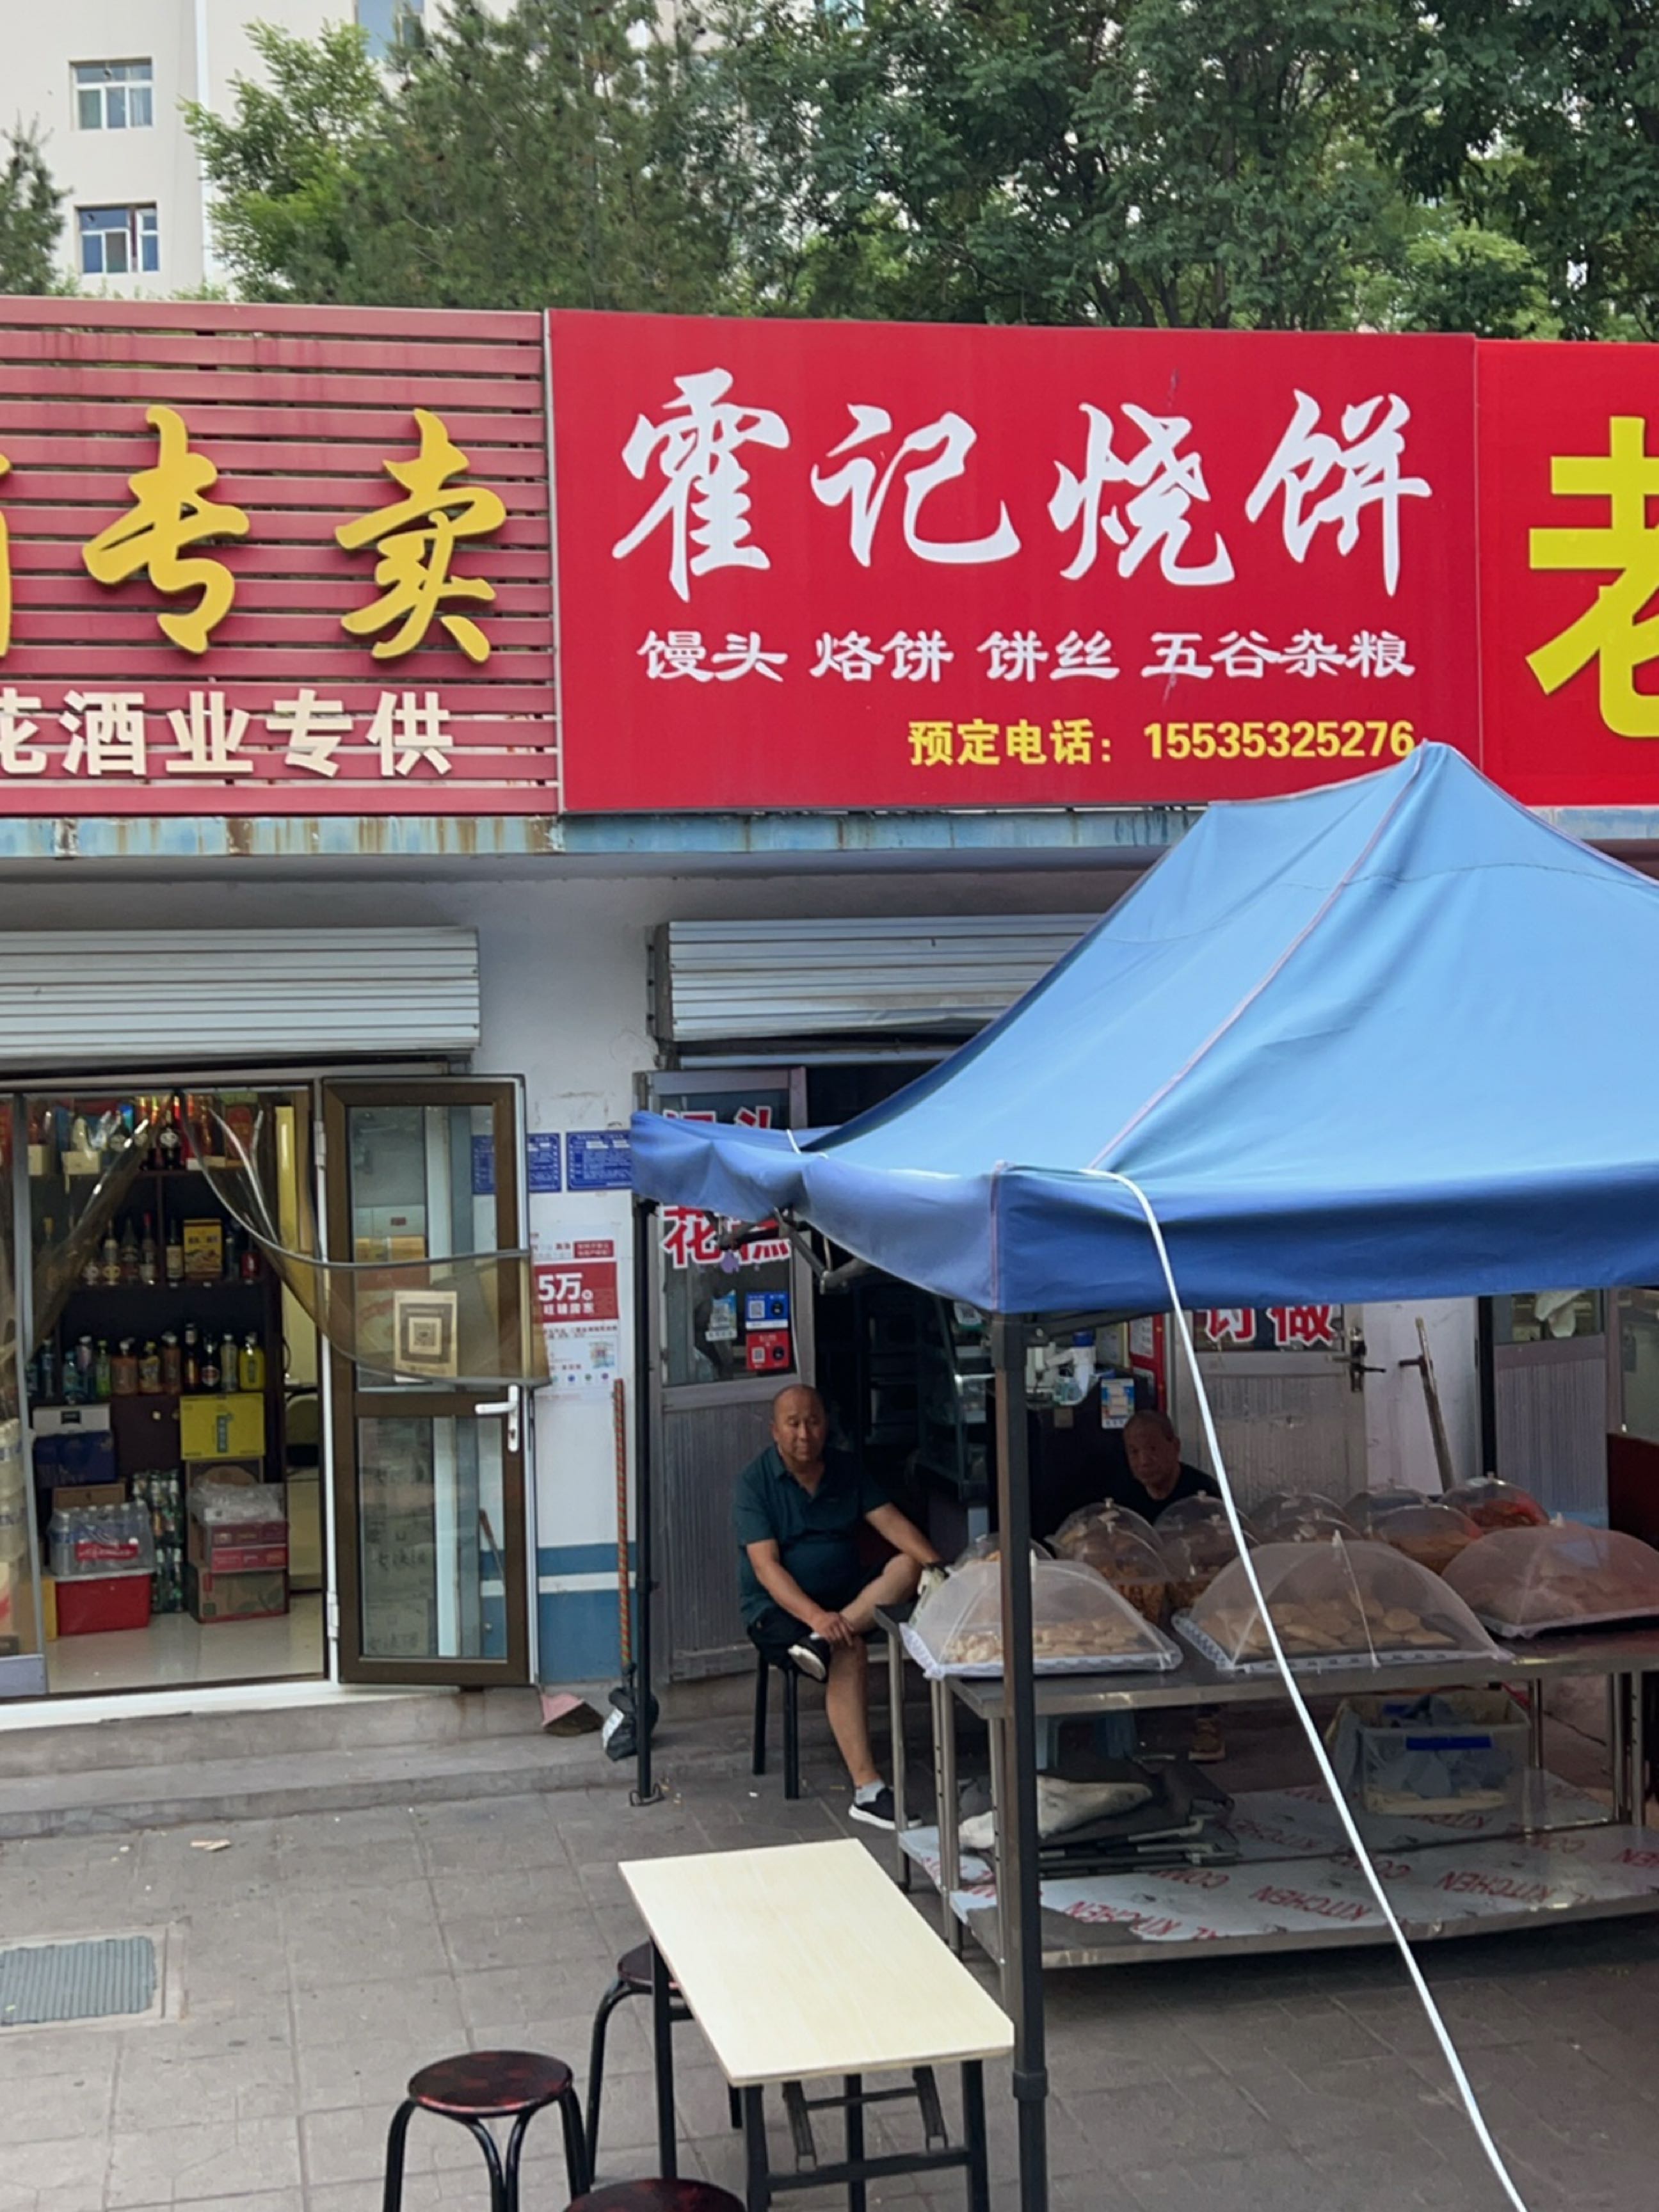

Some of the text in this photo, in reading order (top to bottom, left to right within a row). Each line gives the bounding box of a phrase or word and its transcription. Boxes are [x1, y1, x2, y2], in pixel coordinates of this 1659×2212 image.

[0, 405, 507, 663] 专卖
[612, 367, 1432, 603] 霍记烧饼
[1526, 415, 1659, 738] 老
[637, 630, 1415, 683] 馒头 烙饼 饼丝 五谷杂粮
[1144, 721, 1415, 760] 15535325276
